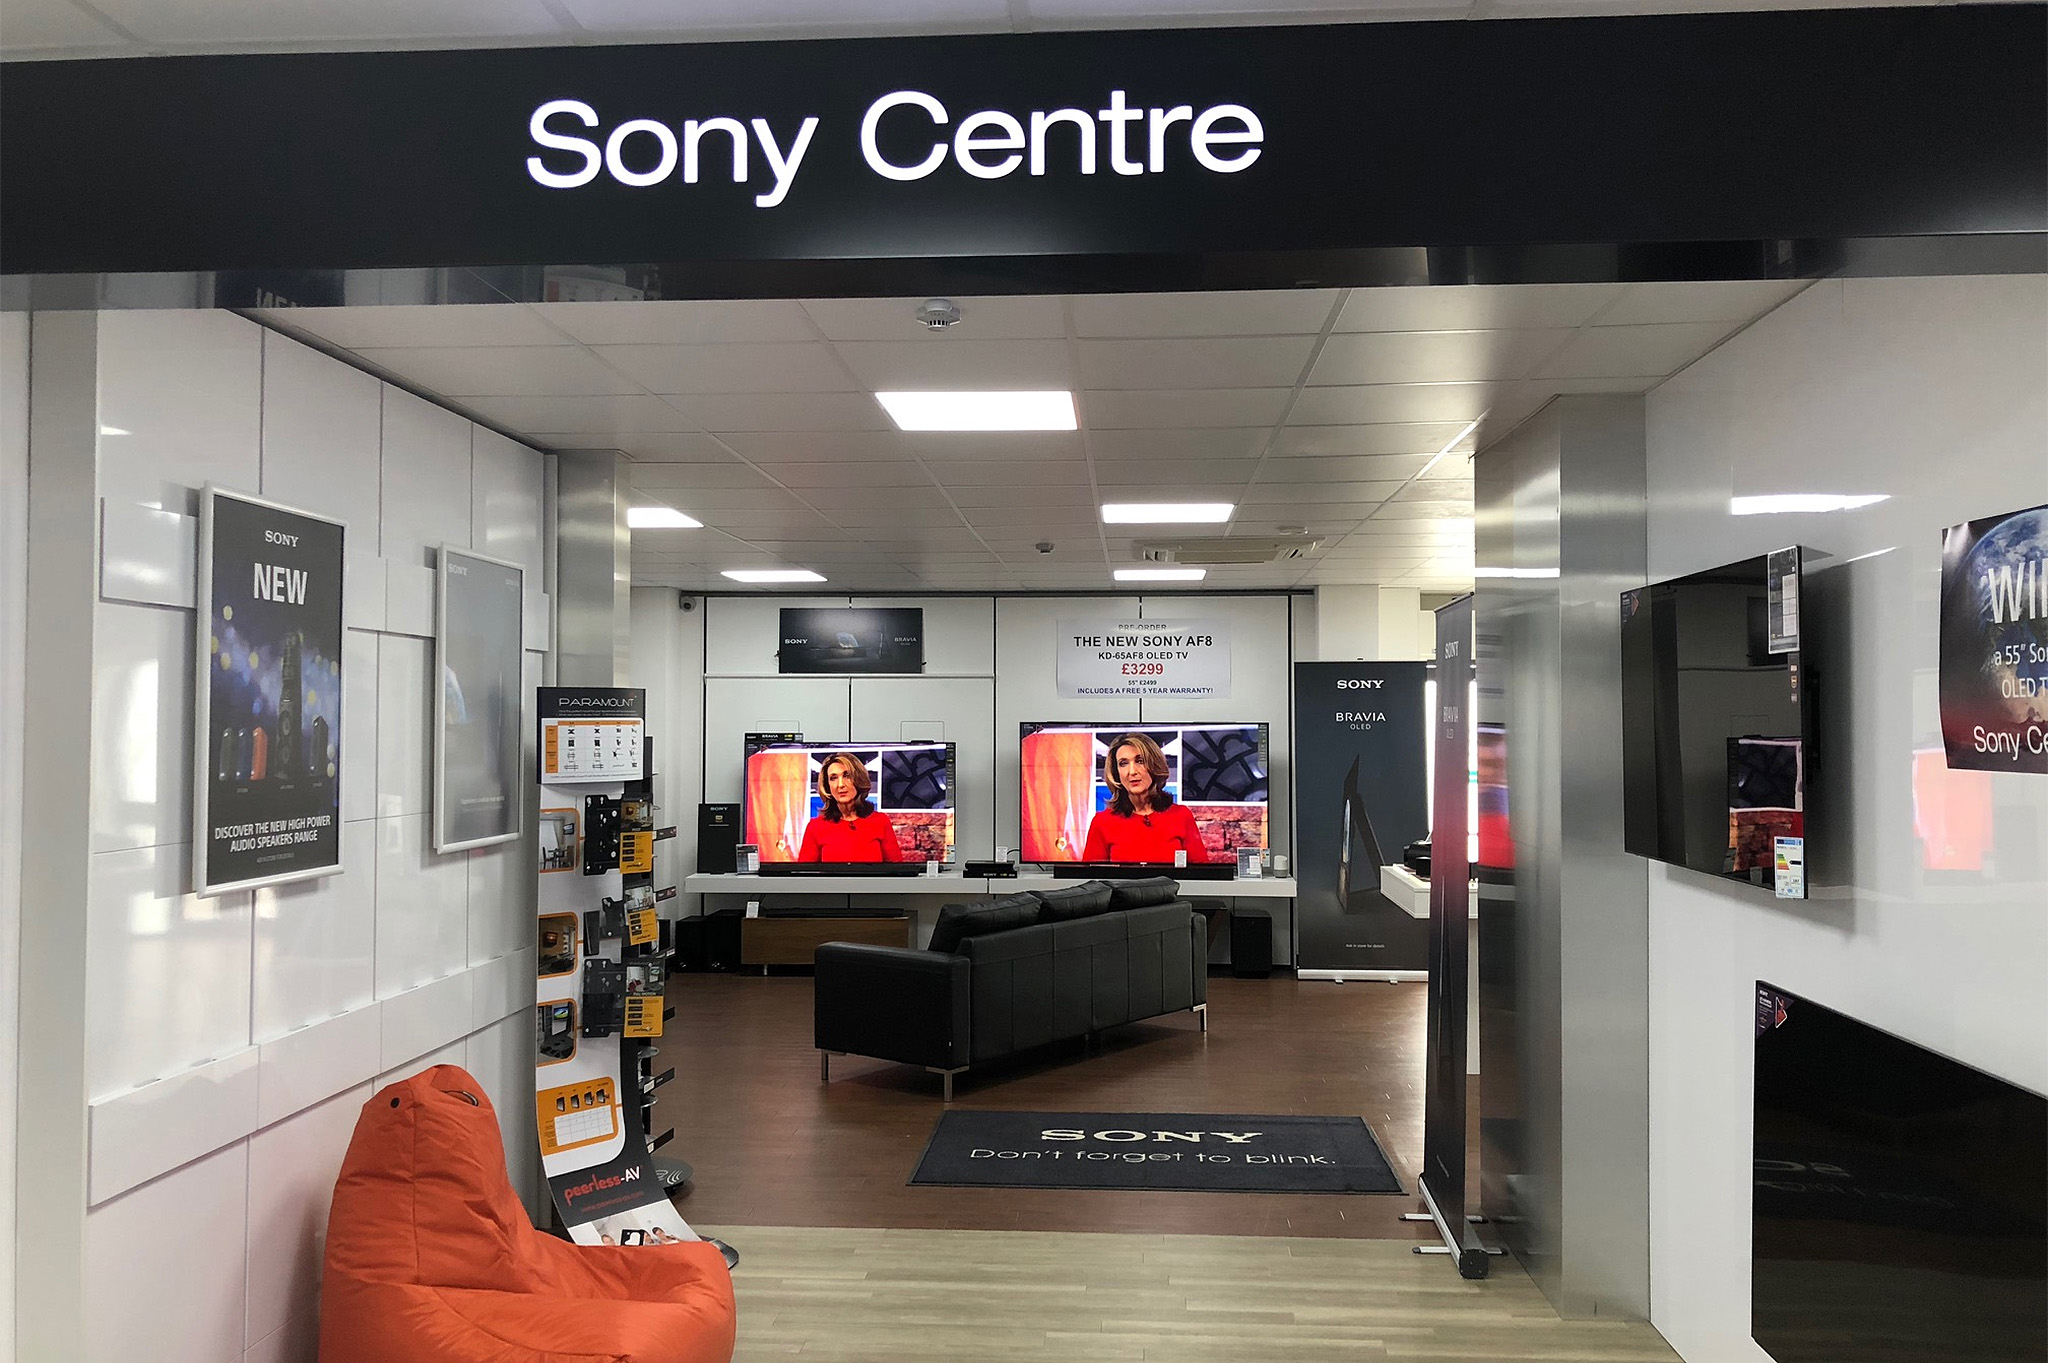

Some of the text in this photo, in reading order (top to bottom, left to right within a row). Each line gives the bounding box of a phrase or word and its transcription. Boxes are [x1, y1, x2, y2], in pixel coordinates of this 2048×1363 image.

[526, 89, 1265, 208] Sony Centre
[265, 530, 299, 547] SONY
[253, 562, 308, 606] NEW
[1074, 635, 1213, 647] THE NEW SONY AF8
[1098, 652, 1189, 660] KD-65AF8 OLED TV
[1994, 651, 2002, 666] a
[2029, 643, 2048, 663] So
[1121, 663, 1164, 675] £3299
[1336, 679, 1385, 689] SONY
[2002, 677, 2036, 699] OLED
[558, 697, 635, 707] PARAMOUNT
[1335, 712, 1387, 722] BRAVIA
[1973, 725, 2020, 761] Sony
[214, 815, 331, 840] DISCOVER THE NEW HIGH POWER
[230, 830, 318, 852] AUDIO SPEAKERS RANGE
[1041, 1129, 1263, 1143] SONY
[970, 1149, 1336, 1164] Don't forget to blink.
[564, 1165, 640, 1207] peerless-AV
